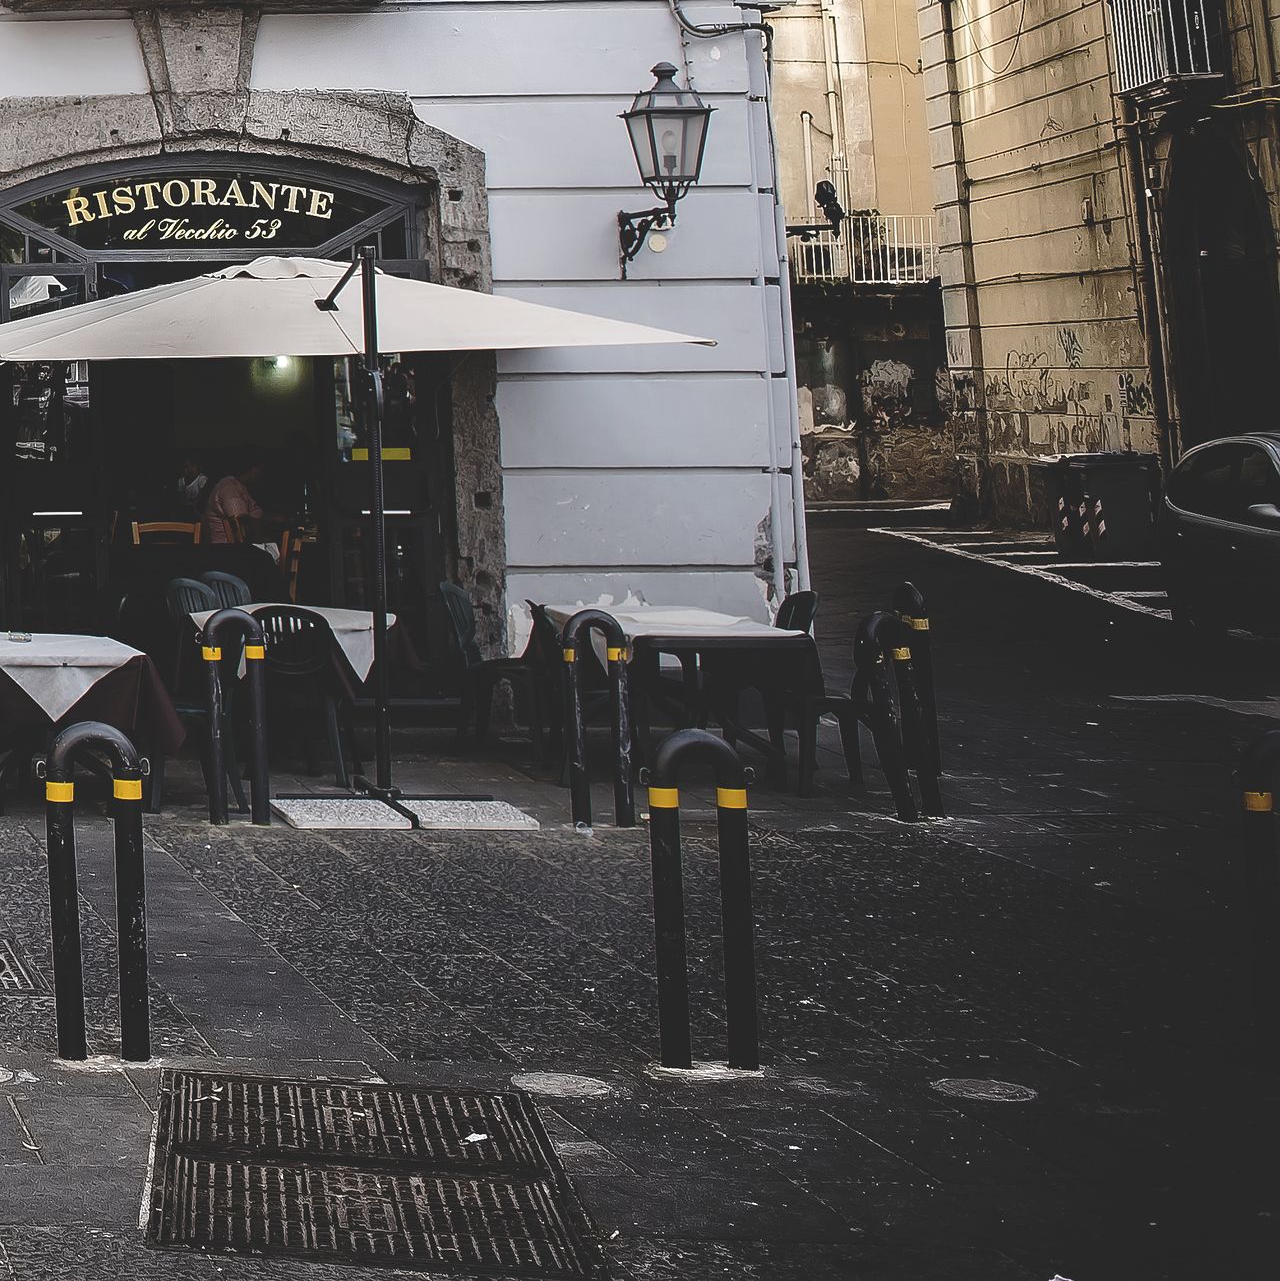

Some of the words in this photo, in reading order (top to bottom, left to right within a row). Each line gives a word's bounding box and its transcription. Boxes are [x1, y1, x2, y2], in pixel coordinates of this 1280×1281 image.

[62, 178, 334, 227] RISTORANTE
[123, 220, 156, 241] al
[157, 218, 239, 241] Vecchio
[244, 218, 282, 240] 53
